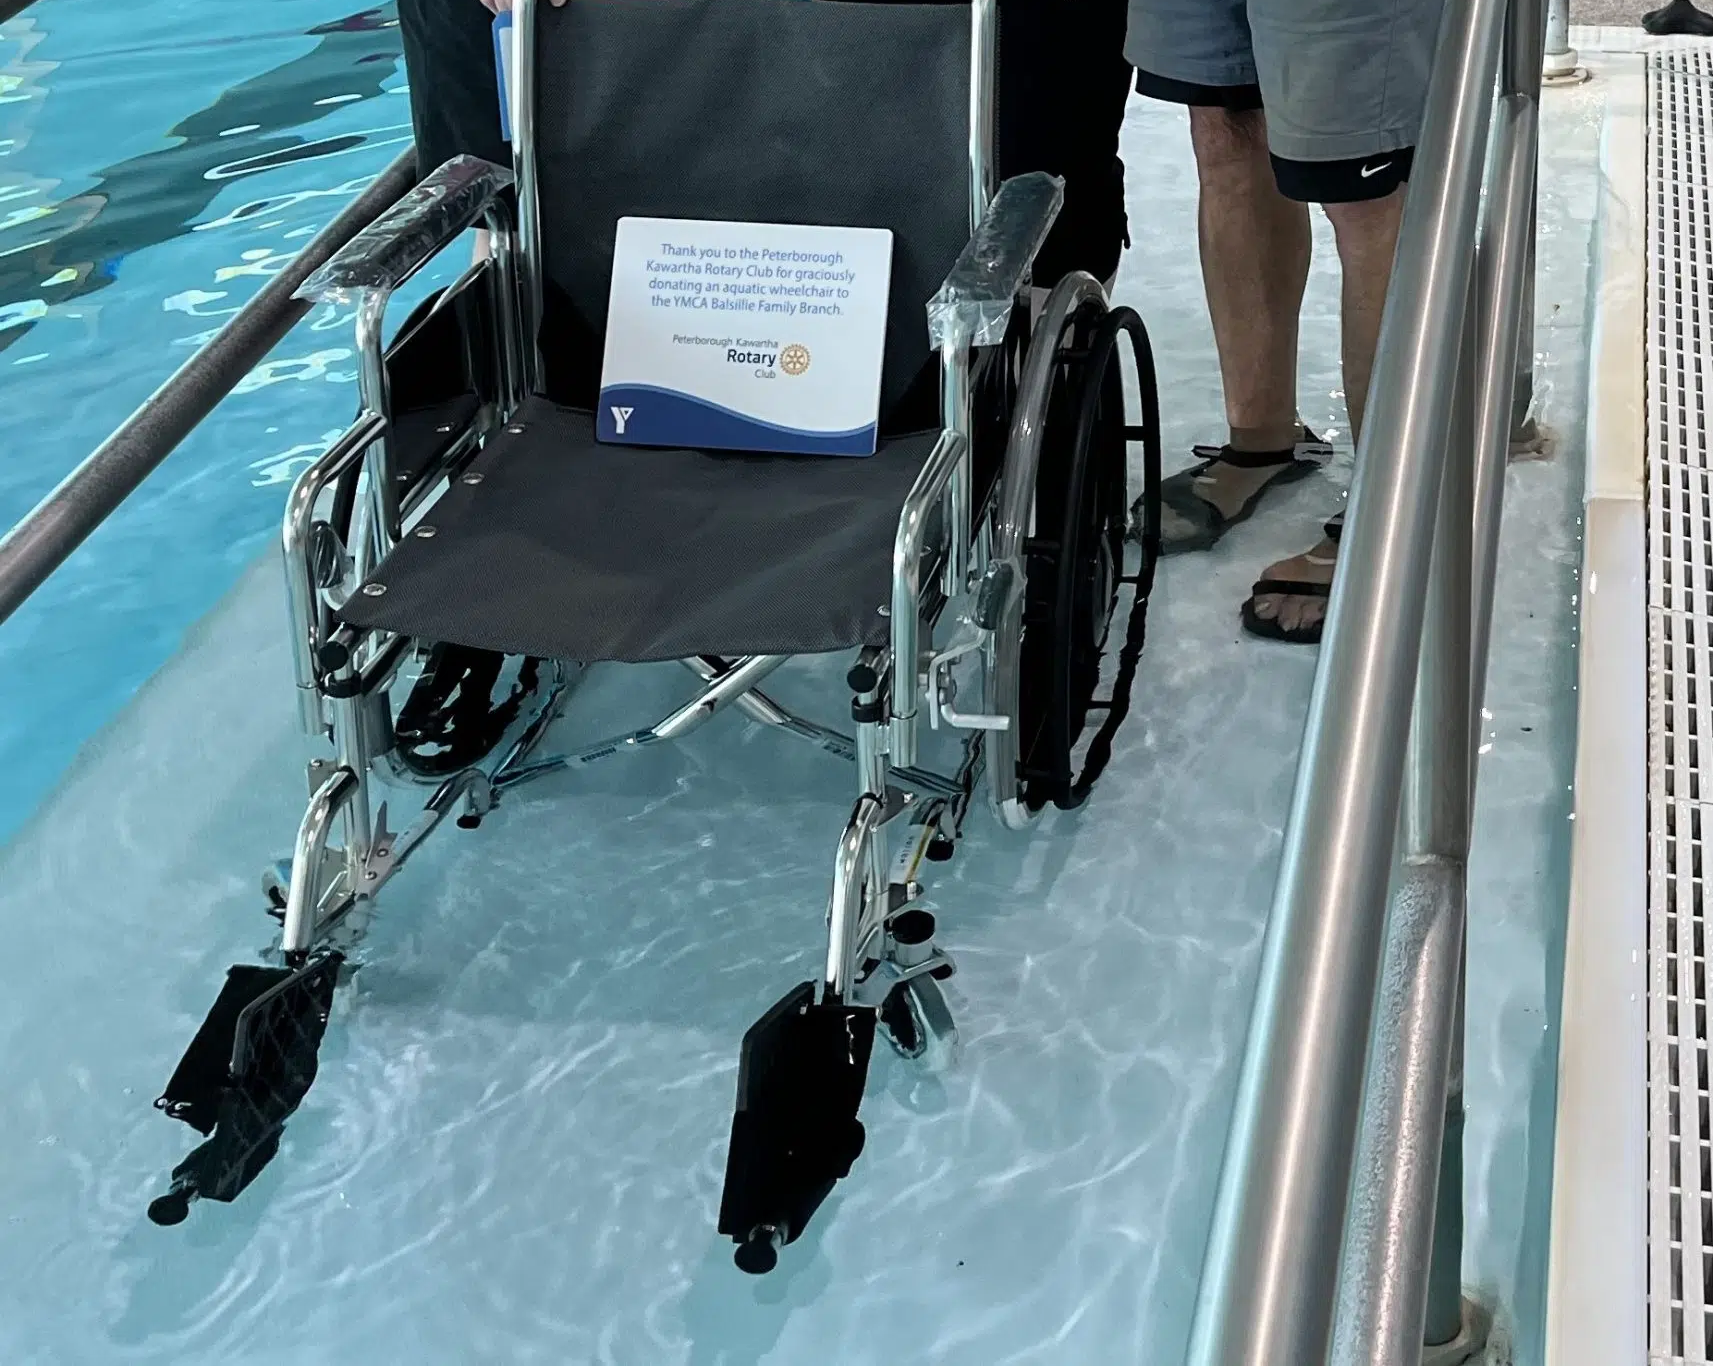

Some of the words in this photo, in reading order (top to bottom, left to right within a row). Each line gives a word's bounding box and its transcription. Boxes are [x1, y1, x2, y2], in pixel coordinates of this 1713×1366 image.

[661, 243, 697, 257] Thank
[699, 247, 721, 260] you
[724, 248, 737, 259] to
[740, 248, 759, 260] the
[761, 249, 844, 264] Peterborough
[646, 260, 701, 275] Kawartha
[704, 263, 743, 278] Rotary
[746, 265, 773, 278] Club
[776, 266, 792, 279] for
[795, 267, 856, 284] graciously
[648, 277, 702, 294] donating
[704, 281, 721, 293] an
[722, 282, 767, 296] aquatic
[769, 284, 834, 298] wheelchair
[837, 287, 850, 299] to
[651, 295, 671, 308] the
[673, 297, 708, 309] YMCA
[711, 298, 755, 311] Balsillie
[758, 300, 797, 315] Family
[672, 334, 733, 348] Peterborough
[735, 337, 779, 348] Kawartha
[727, 348, 777, 367] Rotary
[754, 369, 777, 379] Club
